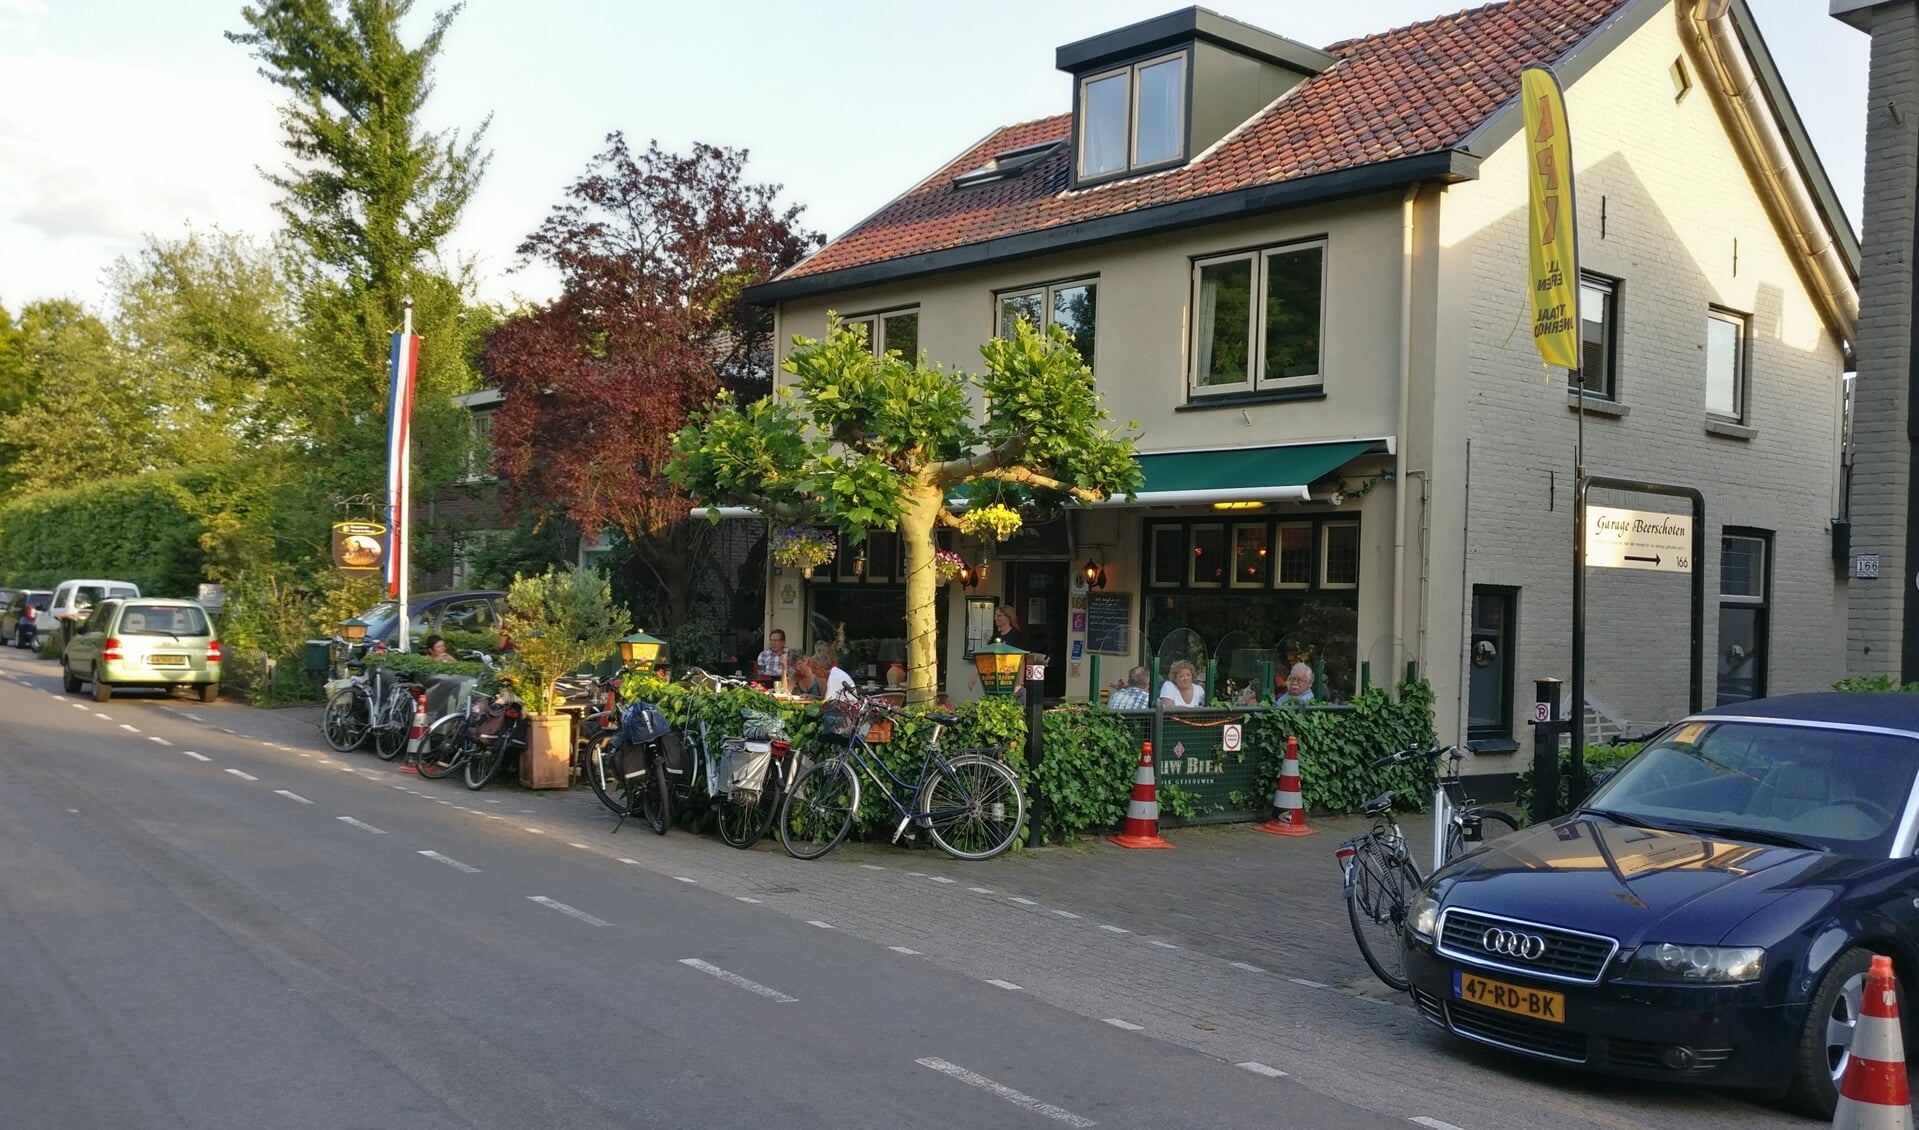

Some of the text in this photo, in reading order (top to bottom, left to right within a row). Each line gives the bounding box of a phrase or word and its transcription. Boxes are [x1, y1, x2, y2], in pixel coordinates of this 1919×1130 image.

[1595, 515, 1685, 538] Garage Beerschoten
[1676, 555, 1689, 568] 166
[1859, 561, 1878, 571] 166
[1466, 978, 1555, 1018] 47-RD-BK
